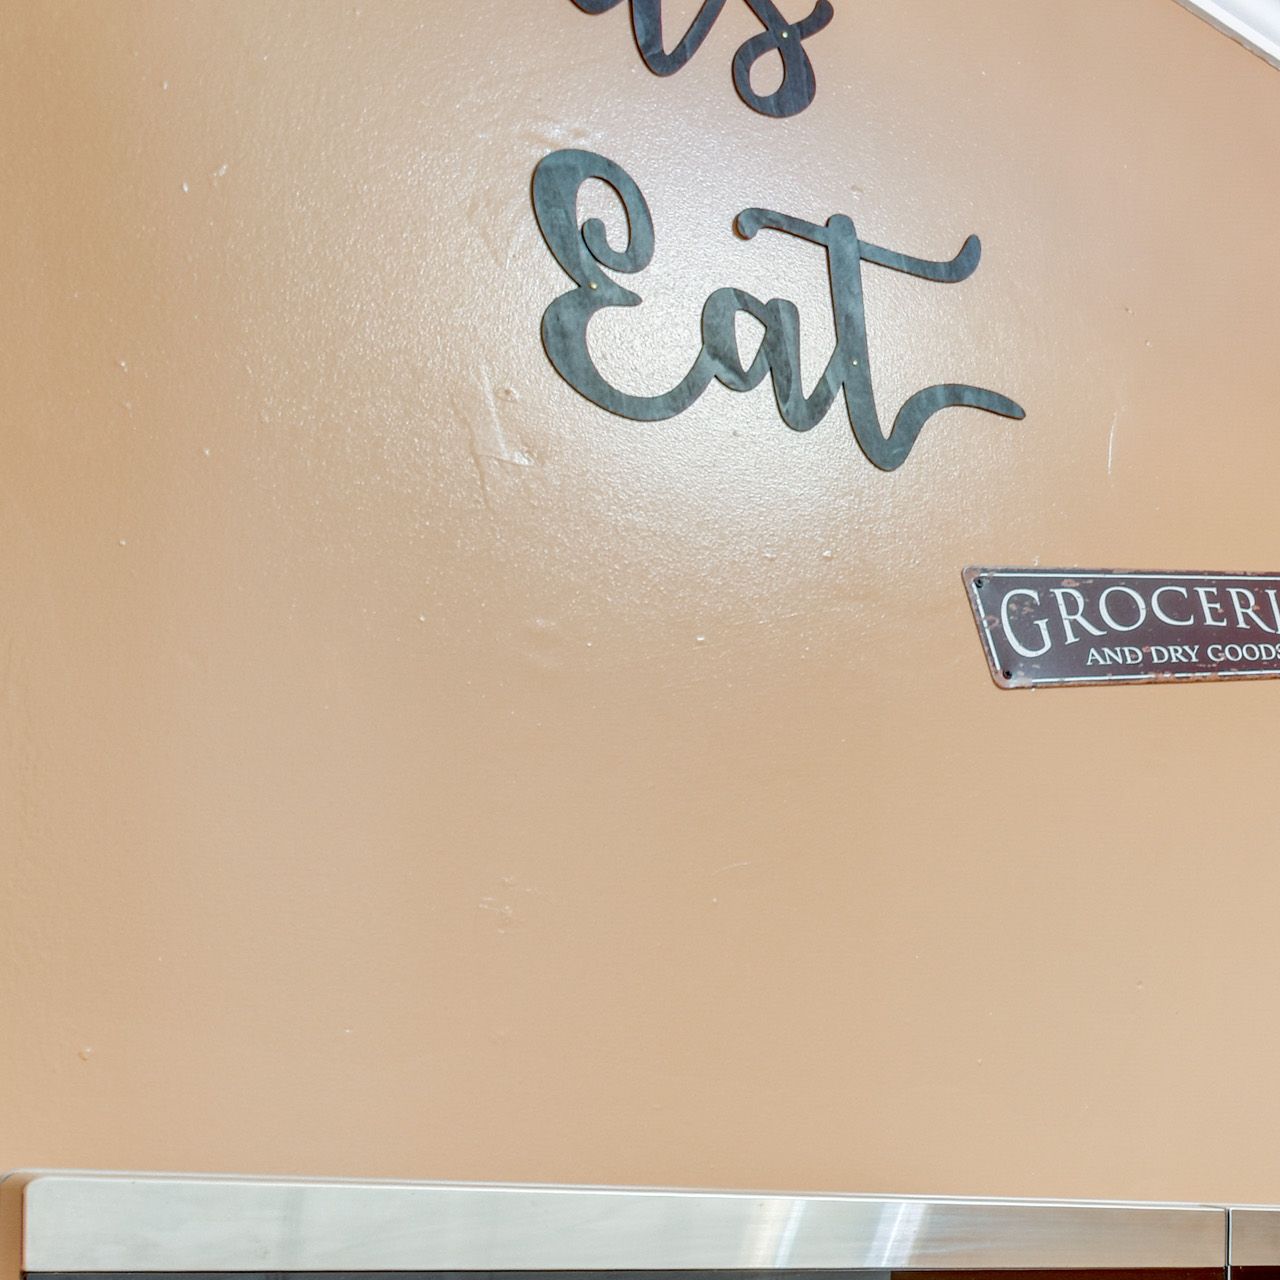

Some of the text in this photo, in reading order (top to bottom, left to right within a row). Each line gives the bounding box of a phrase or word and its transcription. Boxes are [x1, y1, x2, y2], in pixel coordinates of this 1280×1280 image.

[530, 148, 1027, 473] Eat
[1086, 646, 1143, 666] AND
[1150, 645, 1200, 664] DRY
